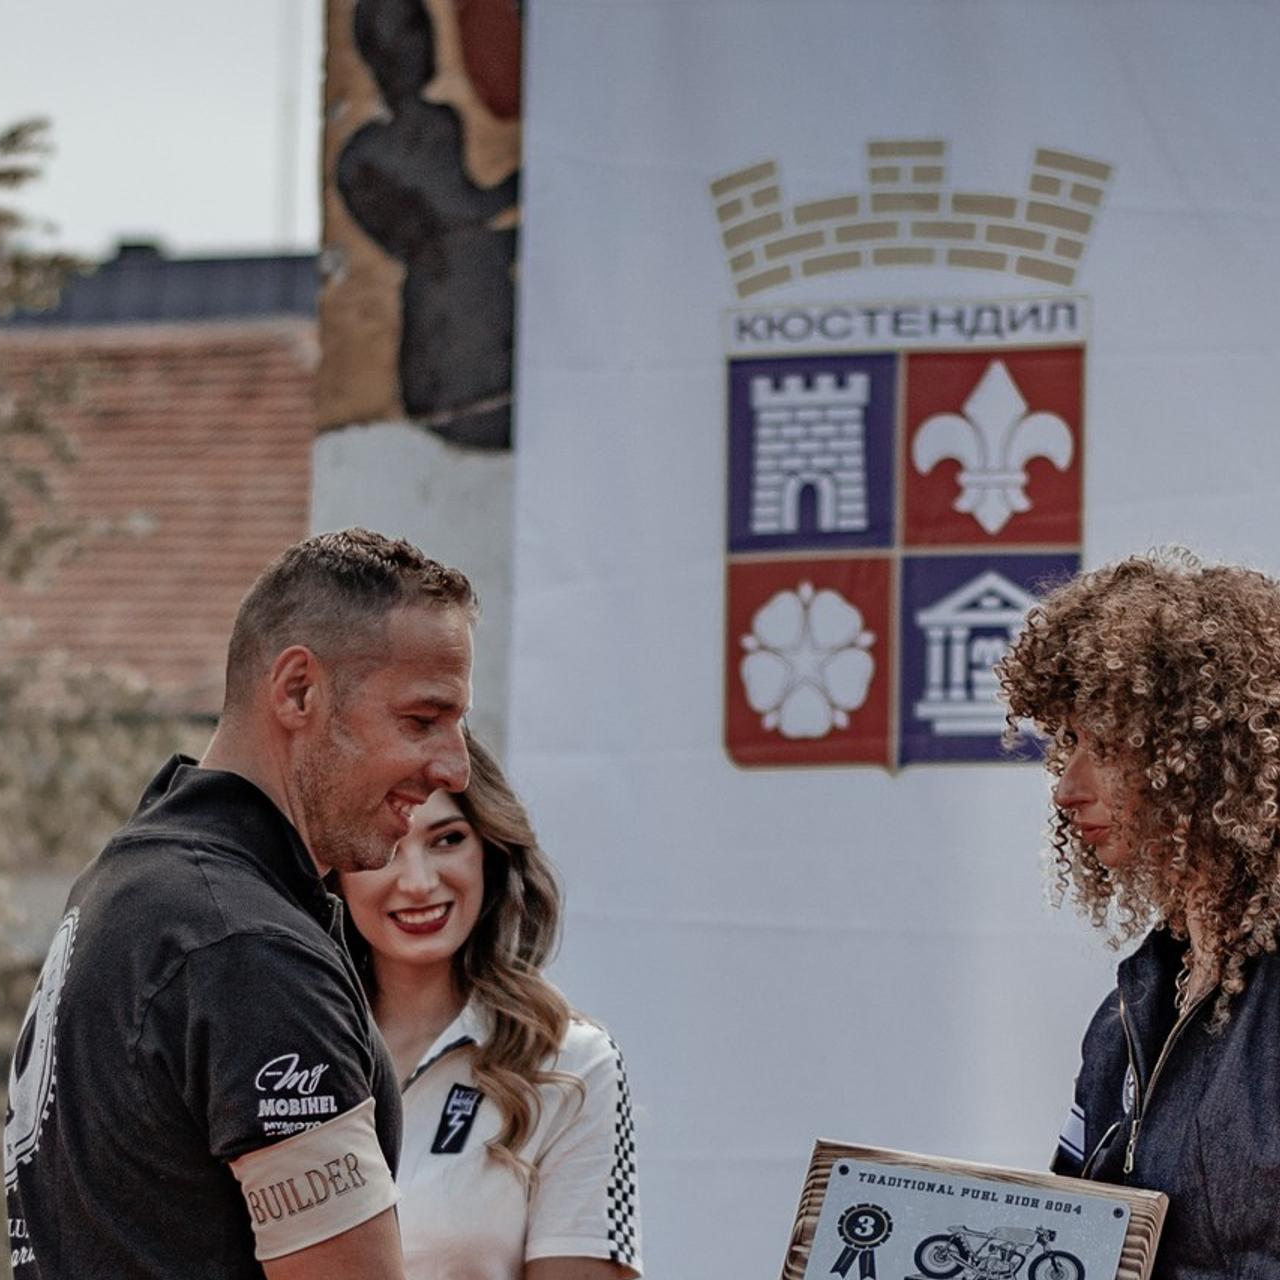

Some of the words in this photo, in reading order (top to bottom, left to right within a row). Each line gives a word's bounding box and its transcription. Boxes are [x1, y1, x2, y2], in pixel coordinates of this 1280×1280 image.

[733, 300, 1078, 343] КЮСТЕНДИЛ
[257, 1095, 338, 1118] MOBIHEL
[247, 1152, 367, 1225] BUILDER
[858, 1172, 955, 1196] TRADITIONAL
[854, 1215, 875, 1237] 3
